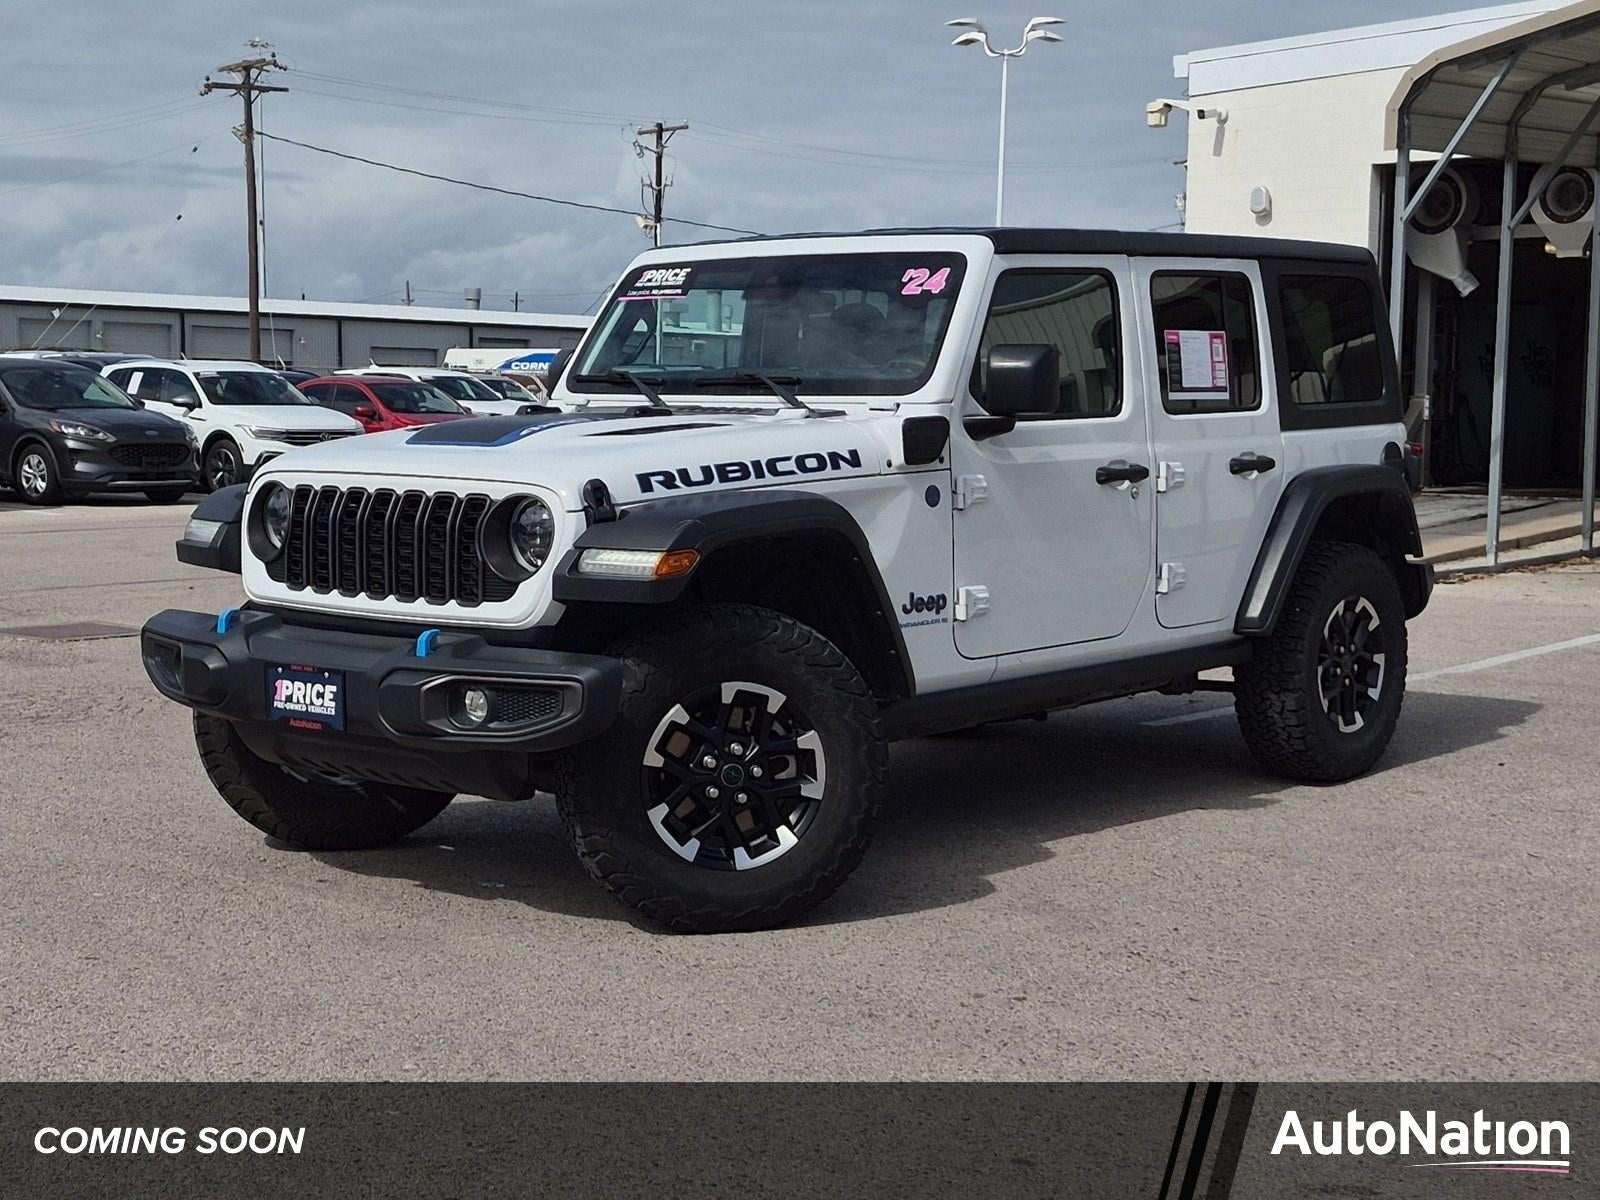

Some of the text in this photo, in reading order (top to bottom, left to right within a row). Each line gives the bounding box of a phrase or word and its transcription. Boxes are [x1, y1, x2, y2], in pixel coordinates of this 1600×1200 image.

[637, 268, 691, 282] 1PRICE
[635, 448, 862, 494] RUBICON
[902, 591, 947, 615] Jeep
[274, 679, 337, 707] 1PRICE
